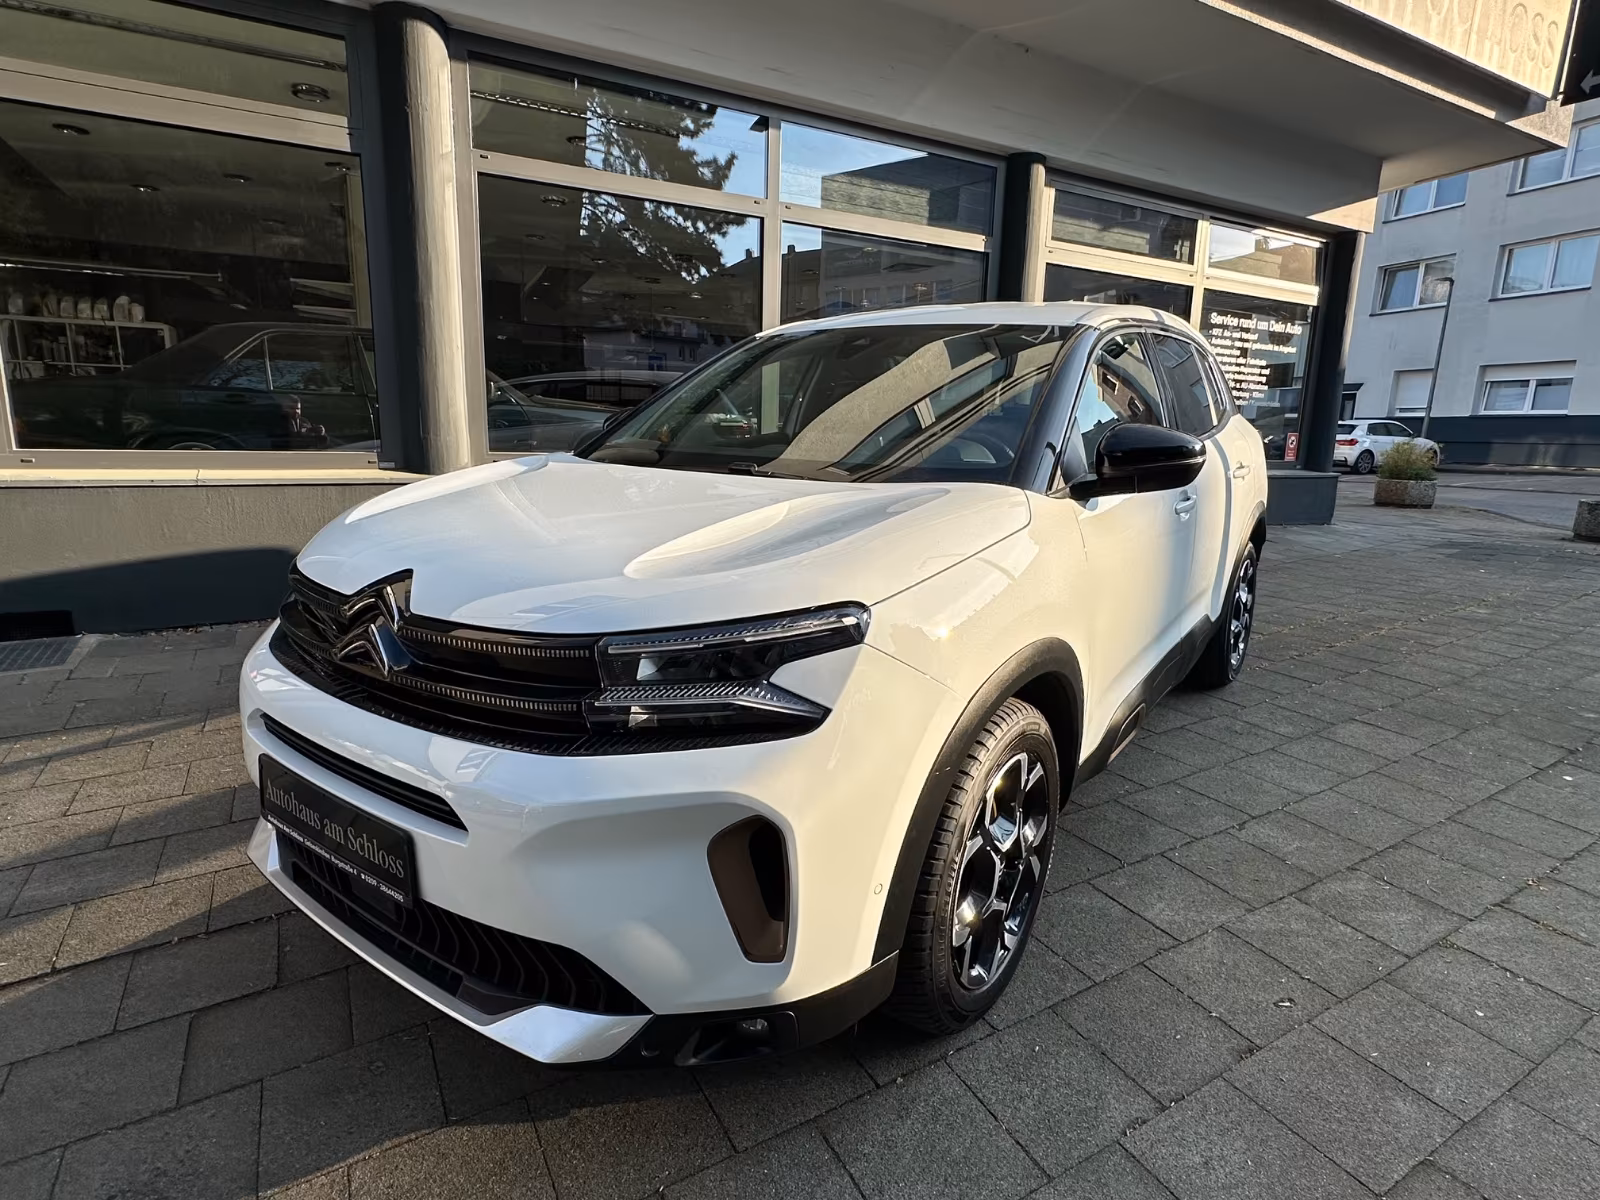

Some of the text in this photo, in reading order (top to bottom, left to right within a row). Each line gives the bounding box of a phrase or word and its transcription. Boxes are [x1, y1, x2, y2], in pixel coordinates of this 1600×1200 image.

[1210, 312, 1302, 335] Service rund um Dein Auto
[265, 778, 405, 878] Autohaus am Schloss
[267, 814, 284, 829] Autohaus
